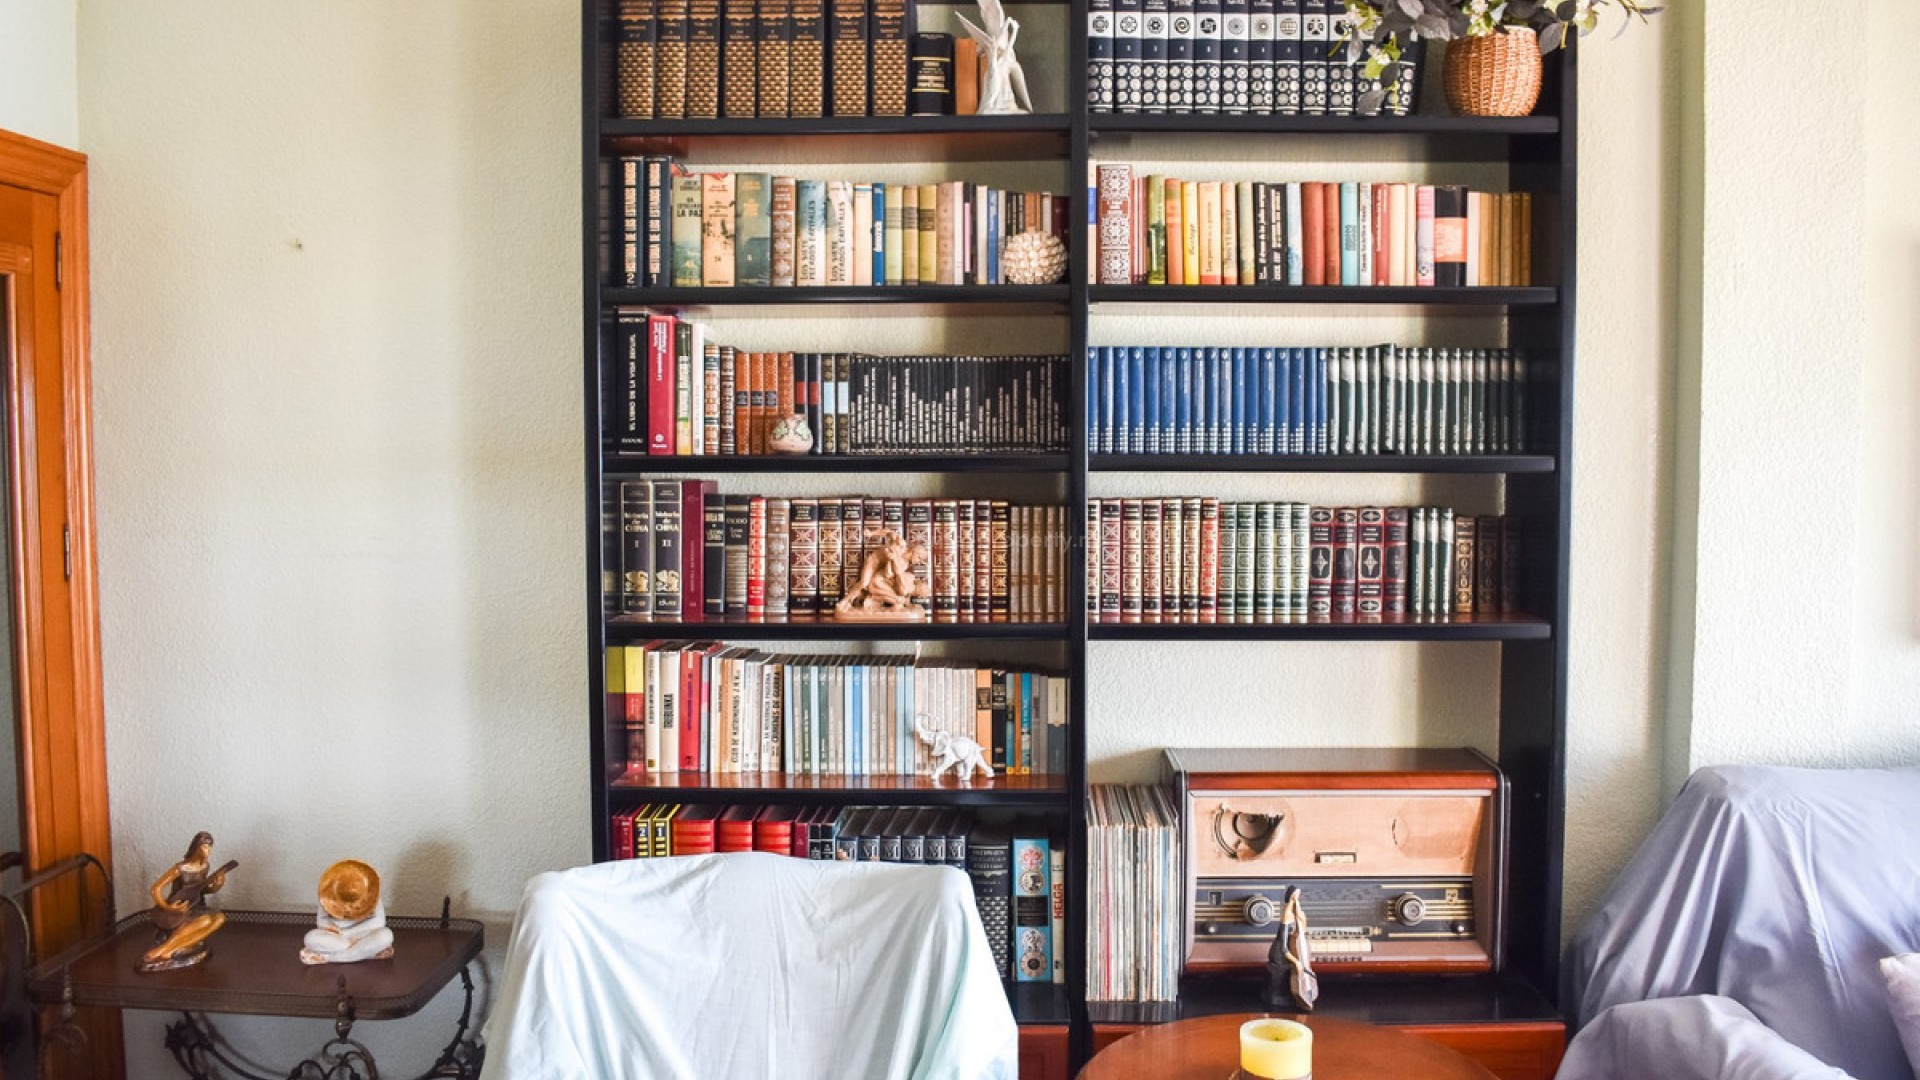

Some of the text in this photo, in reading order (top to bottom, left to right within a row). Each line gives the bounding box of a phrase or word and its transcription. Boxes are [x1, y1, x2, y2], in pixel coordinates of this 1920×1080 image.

[676, 209, 686, 217] LA
[807, 200, 816, 280] PECADOS CAPITALES
[838, 201, 846, 282] PECADOS CAPITALES
[800, 240, 808, 280] LOS SIETE
[830, 240, 838, 282] LOS SIETE
[626, 273, 634, 284] 2
[651, 274, 657, 284] 1
[629, 379, 636, 388] LA
[629, 390, 636, 399] DE
[629, 421, 636, 431] EL
[625, 524, 648, 532] CHINA
[656, 524, 679, 532] CHINA
[771, 672, 780, 744] CRIMENES DE GUERRA
[763, 731, 770, 739] LA
[638, 827, 646, 836] 2
[657, 827, 662, 836] 1
[1053, 883, 1063, 919] HELGA
